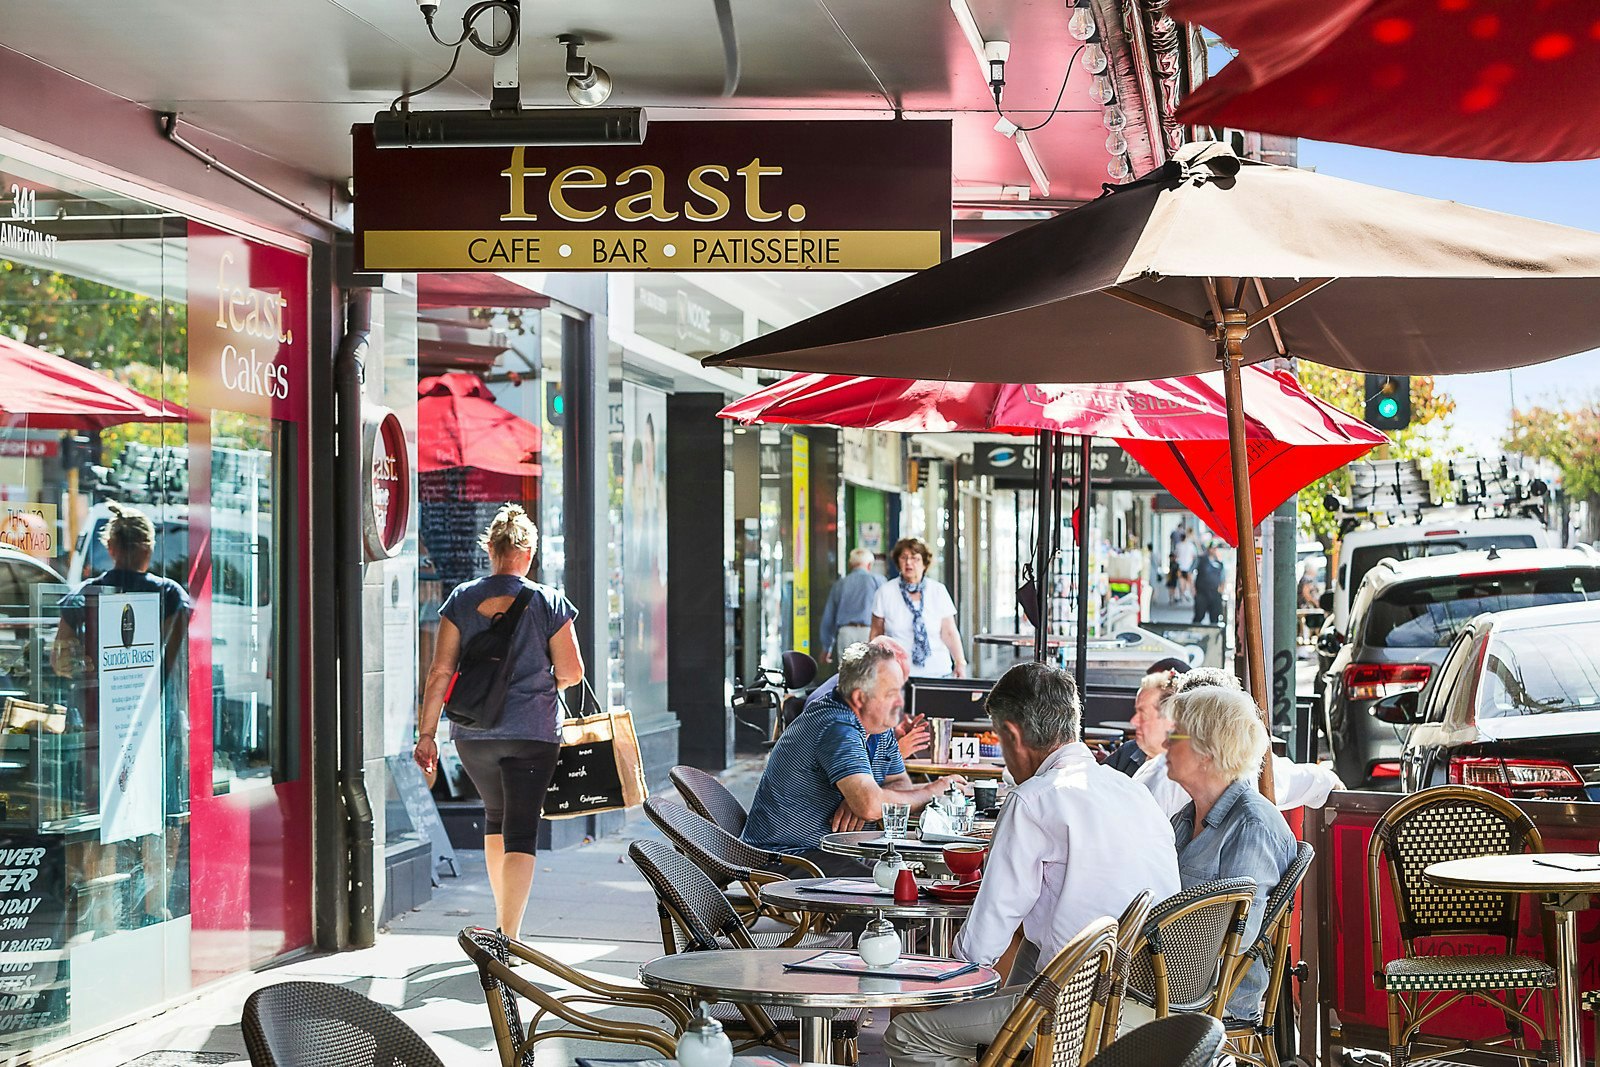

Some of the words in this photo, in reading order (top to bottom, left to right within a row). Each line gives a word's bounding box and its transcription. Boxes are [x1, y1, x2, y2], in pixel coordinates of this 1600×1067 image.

[500, 146, 807, 223] feast.
[11, 183, 36, 225] 341
[468, 237, 541, 264] CAFE
[592, 237, 649, 264] BAR
[692, 237, 840, 264] PATISSERIE
[215, 251, 293, 345] feast.
[221, 344, 289, 400] Cakes
[103, 649, 130, 668] Sunday
[132, 649, 154, 664] Roast
[957, 742, 974, 758] 14
[9, 937, 52, 952] BAKED
[0, 1011, 51, 1031] OFFEE
